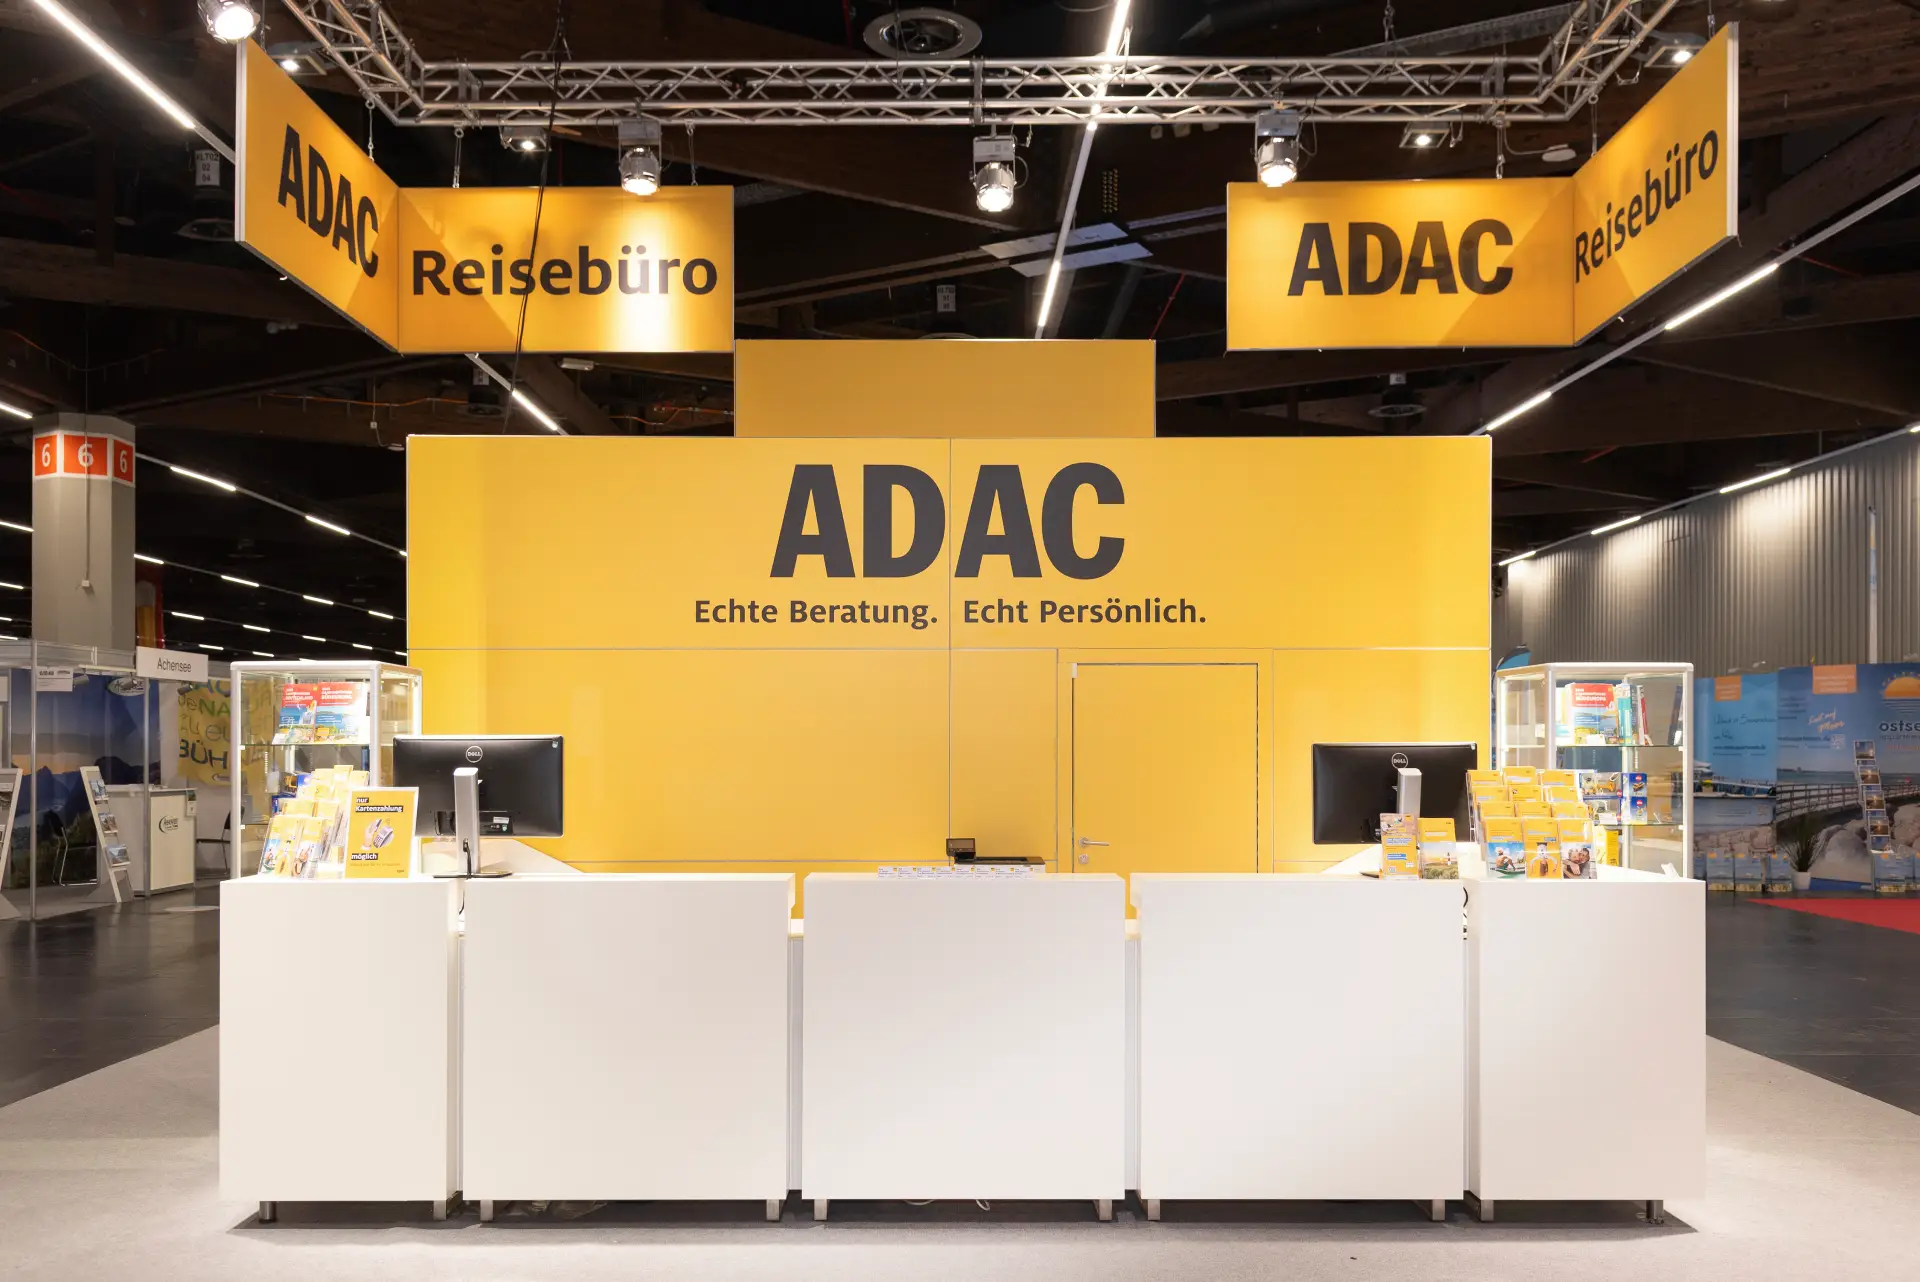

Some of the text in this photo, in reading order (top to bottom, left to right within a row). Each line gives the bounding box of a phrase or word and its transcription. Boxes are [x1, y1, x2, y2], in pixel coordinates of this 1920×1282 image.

[278, 123, 379, 278] ADAC
[1575, 129, 1719, 284] Reisebüro
[412, 244, 719, 296] Reisebüro
[1287, 218, 1514, 297] ADAC
[42, 443, 51, 468] 6
[78, 443, 94, 468] 6
[120, 450, 128, 473] 6
[769, 462, 1125, 580] ADAC
[695, 597, 1206, 630] Echte Beratung. Echt Persönlich.
[157, 658, 192, 673] Achensee
